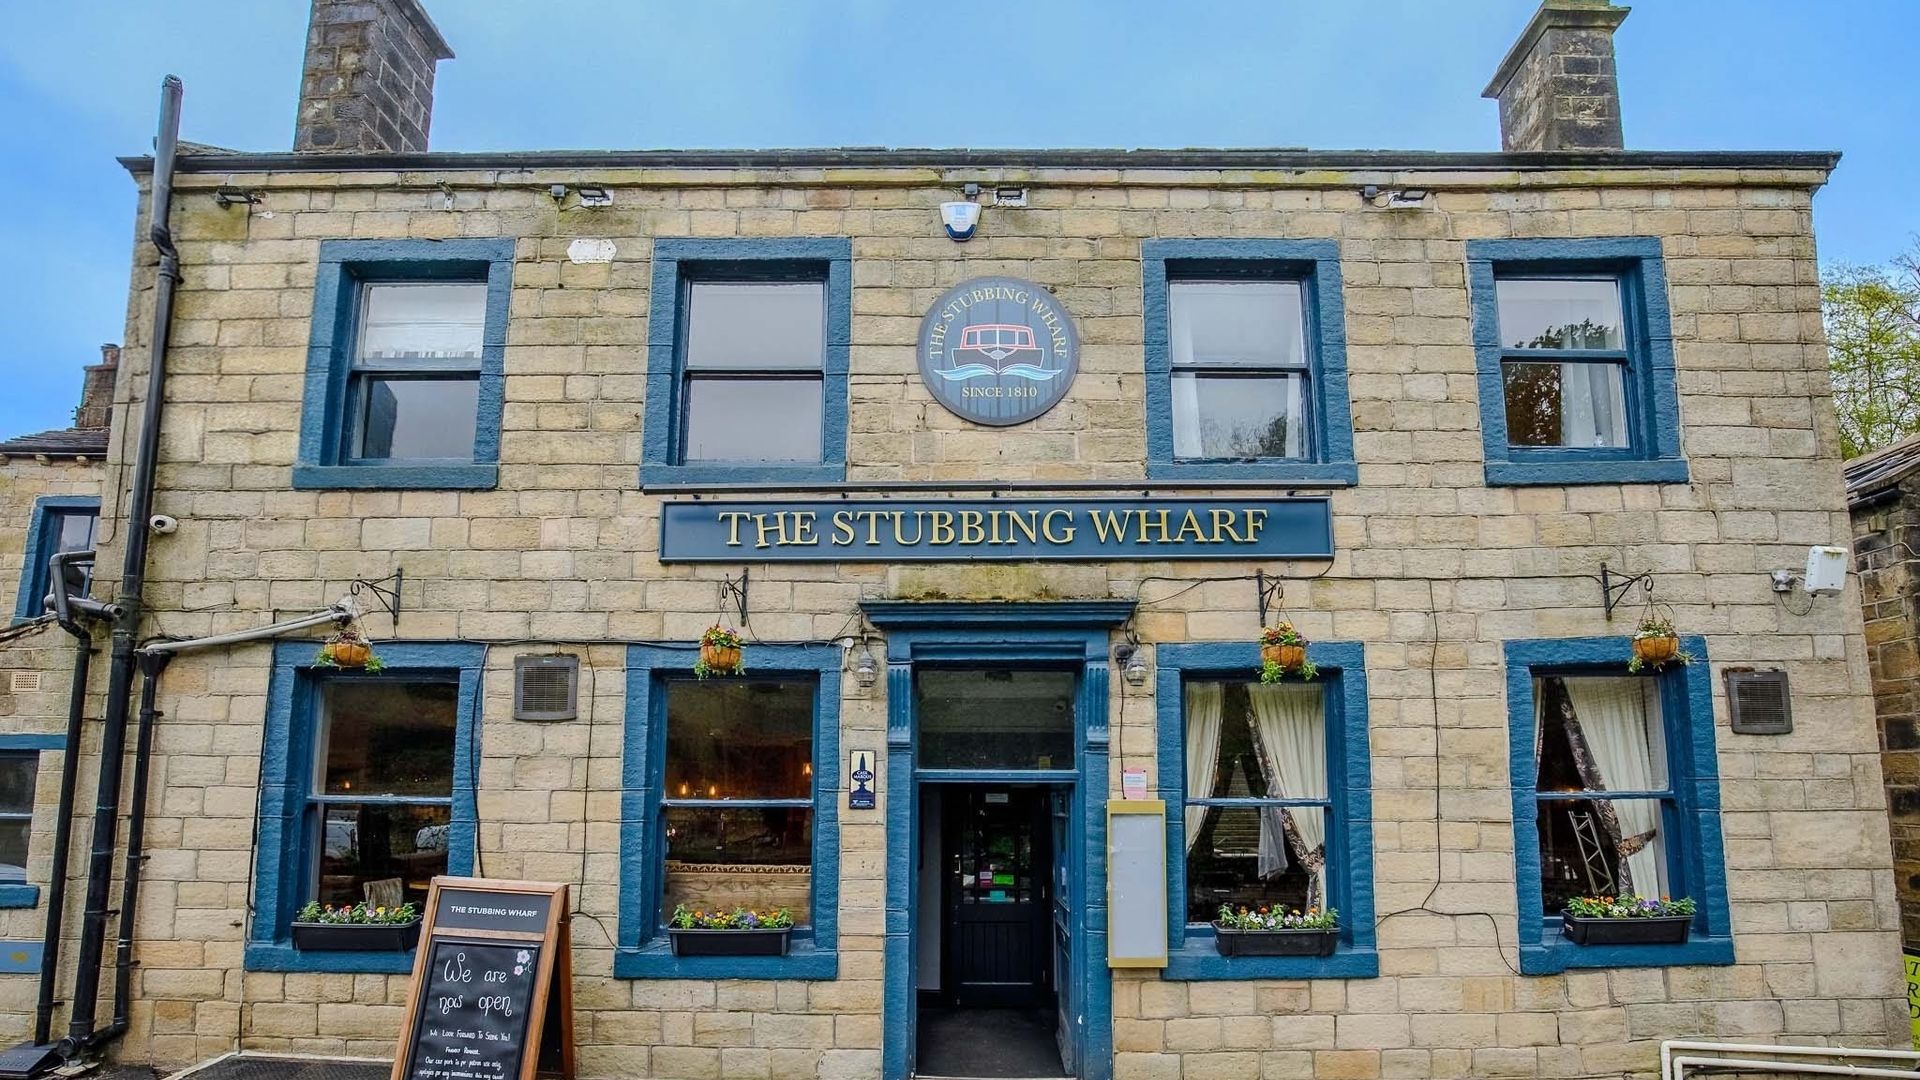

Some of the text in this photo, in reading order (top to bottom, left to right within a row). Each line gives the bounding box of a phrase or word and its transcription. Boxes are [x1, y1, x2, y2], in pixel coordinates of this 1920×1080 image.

[929, 287, 1068, 360] THE STUBBING WHARF
[961, 386, 1038, 398] SINCE 1810
[719, 508, 1269, 549] THE STUBBING WHARF
[450, 905, 538, 918] THE STUBBING WHARF
[444, 952, 508, 984] We are
[478, 995, 513, 1017] open
